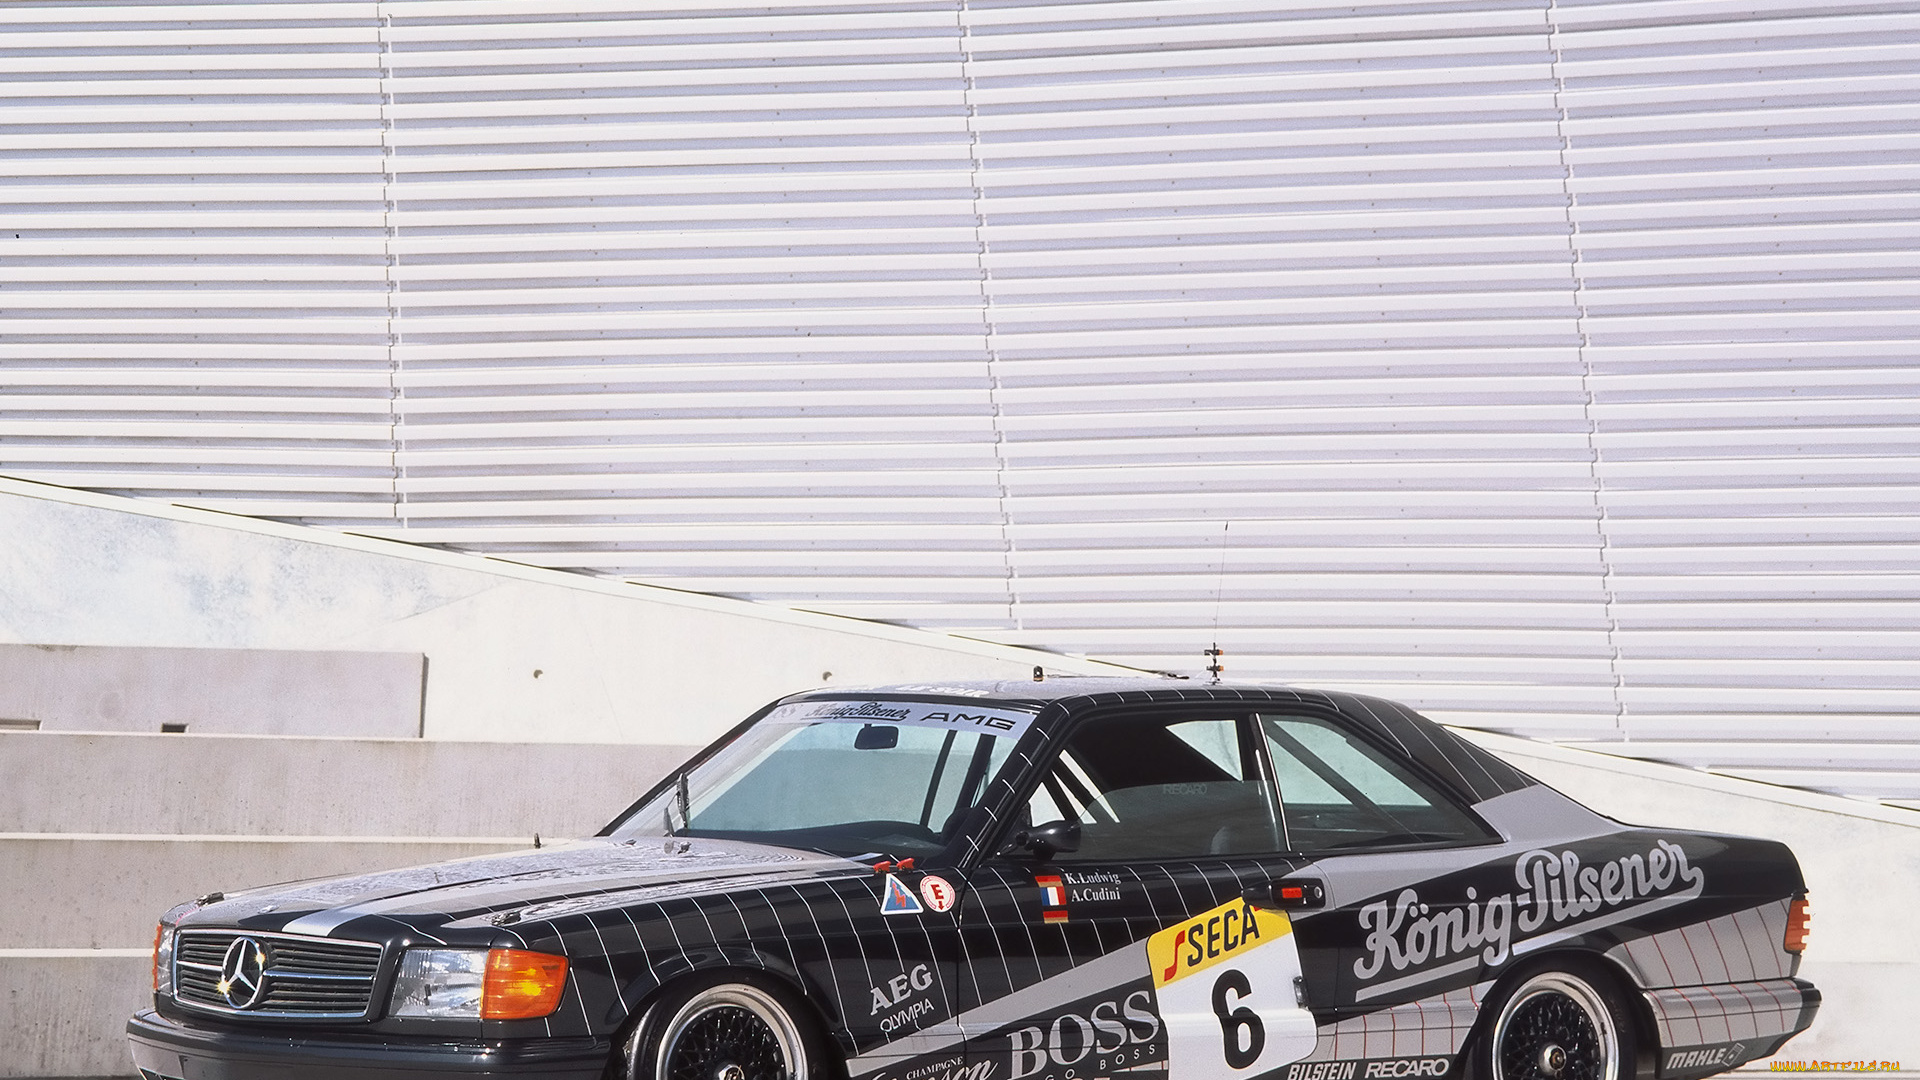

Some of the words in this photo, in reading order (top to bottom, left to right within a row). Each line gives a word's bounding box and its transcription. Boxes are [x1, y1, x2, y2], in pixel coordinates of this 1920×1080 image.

[920, 711, 1017, 731] AMG
[1162, 783, 1208, 795] RECARO
[1065, 871, 1121, 885] K.Ludwig
[1071, 887, 1121, 902] A.Cudini
[1353, 839, 1705, 980] König-Pilsener
[870, 963, 933, 1016] AEG
[880, 998, 935, 1032] OLYMPIA
[1211, 968, 1266, 1070] 6
[1006, 990, 1160, 1080] BOSS
[906, 1056, 964, 1080] CHAMPAGNE
[1099, 1044, 1156, 1070] BOSS
[1286, 1062, 1357, 1080] BILSTEIN
[1364, 1058, 1450, 1079] RECARO
[1666, 1047, 1727, 1070] MAHLE
